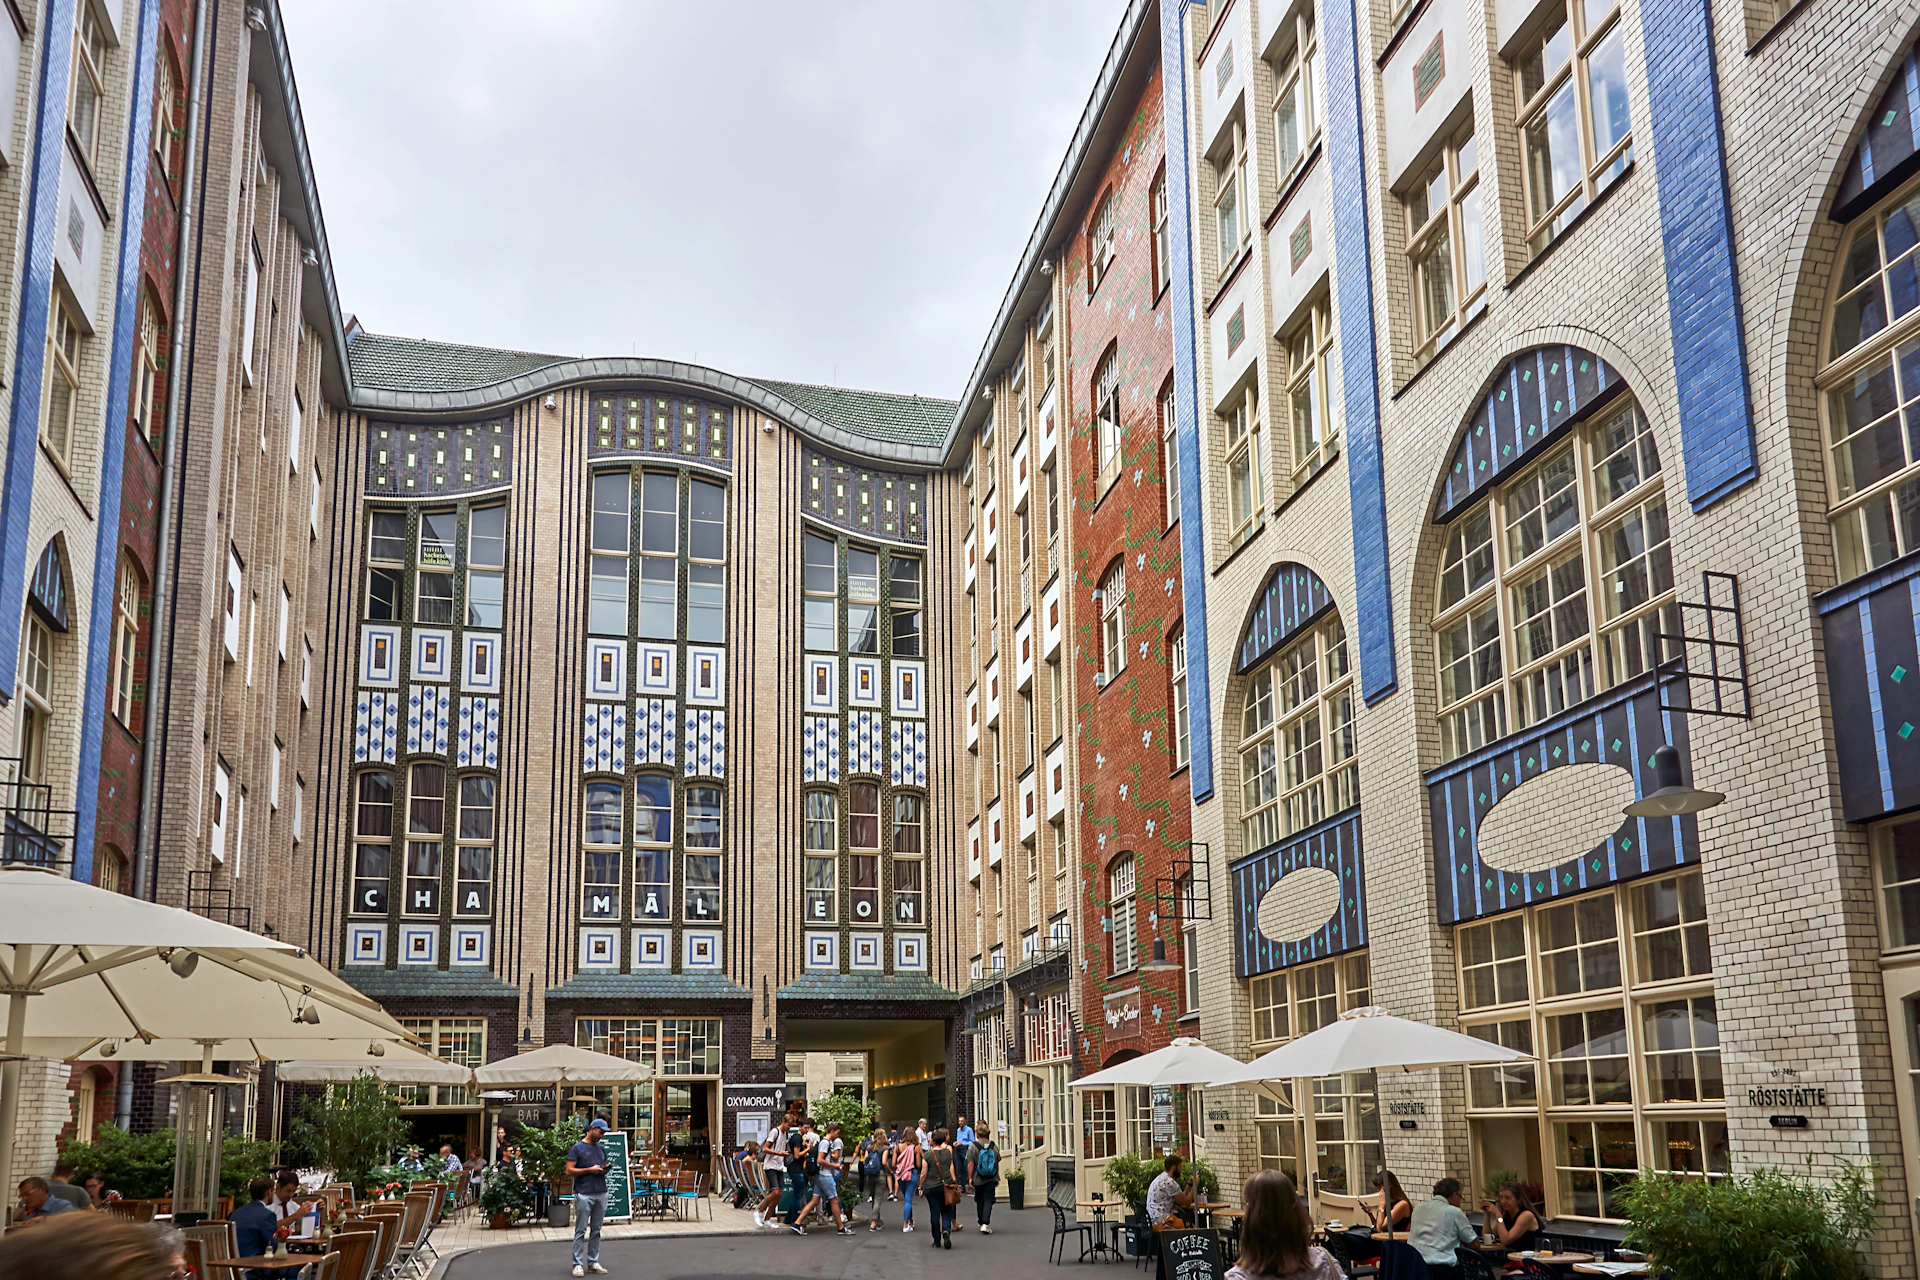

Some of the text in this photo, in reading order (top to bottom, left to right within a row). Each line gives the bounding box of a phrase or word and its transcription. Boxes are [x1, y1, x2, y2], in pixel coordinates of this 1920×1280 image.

[424, 552, 452, 560] hackesche
[503, 1089, 565, 1102] STAURANT
[726, 1096, 774, 1107] OXYMORON
[1748, 1085, 1826, 1106] RÖSTSTÄTTE
[1389, 1100, 1425, 1115] RÖSTSTÄTTE
[518, 1109, 540, 1121] BAR
[1170, 1234, 1210, 1254] COFFEE
